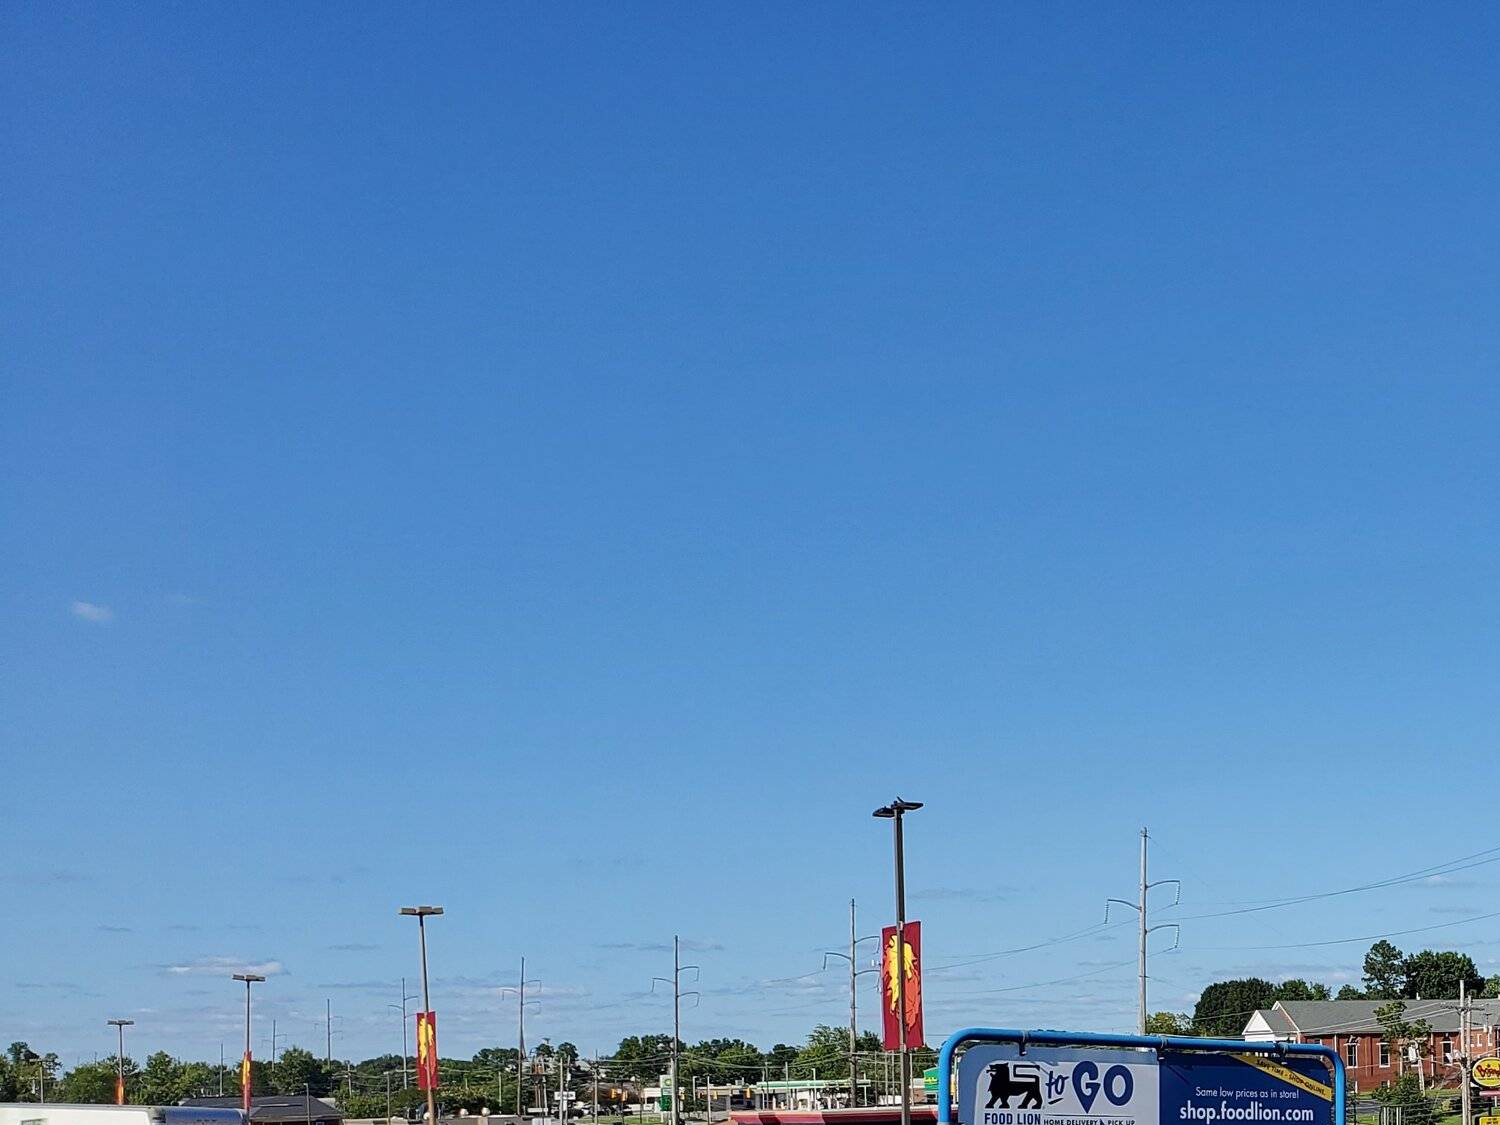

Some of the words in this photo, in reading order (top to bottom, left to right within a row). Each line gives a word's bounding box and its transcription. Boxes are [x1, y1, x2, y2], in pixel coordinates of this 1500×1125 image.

[1045, 1070, 1069, 1101] to
[1072, 1060, 1134, 1114] GO
[1196, 1087, 1218, 1097] Same
[1219, 1088, 1233, 1098] low
[1235, 1089, 1258, 1100] prices
[1270, 1089, 1278, 1098] in
[1279, 1089, 1300, 1099] store!
[984, 1113, 1013, 1125] FOOD
[1017, 1113, 1041, 1125] LION
[1179, 1100, 1314, 1125] shop.foodlion.com
